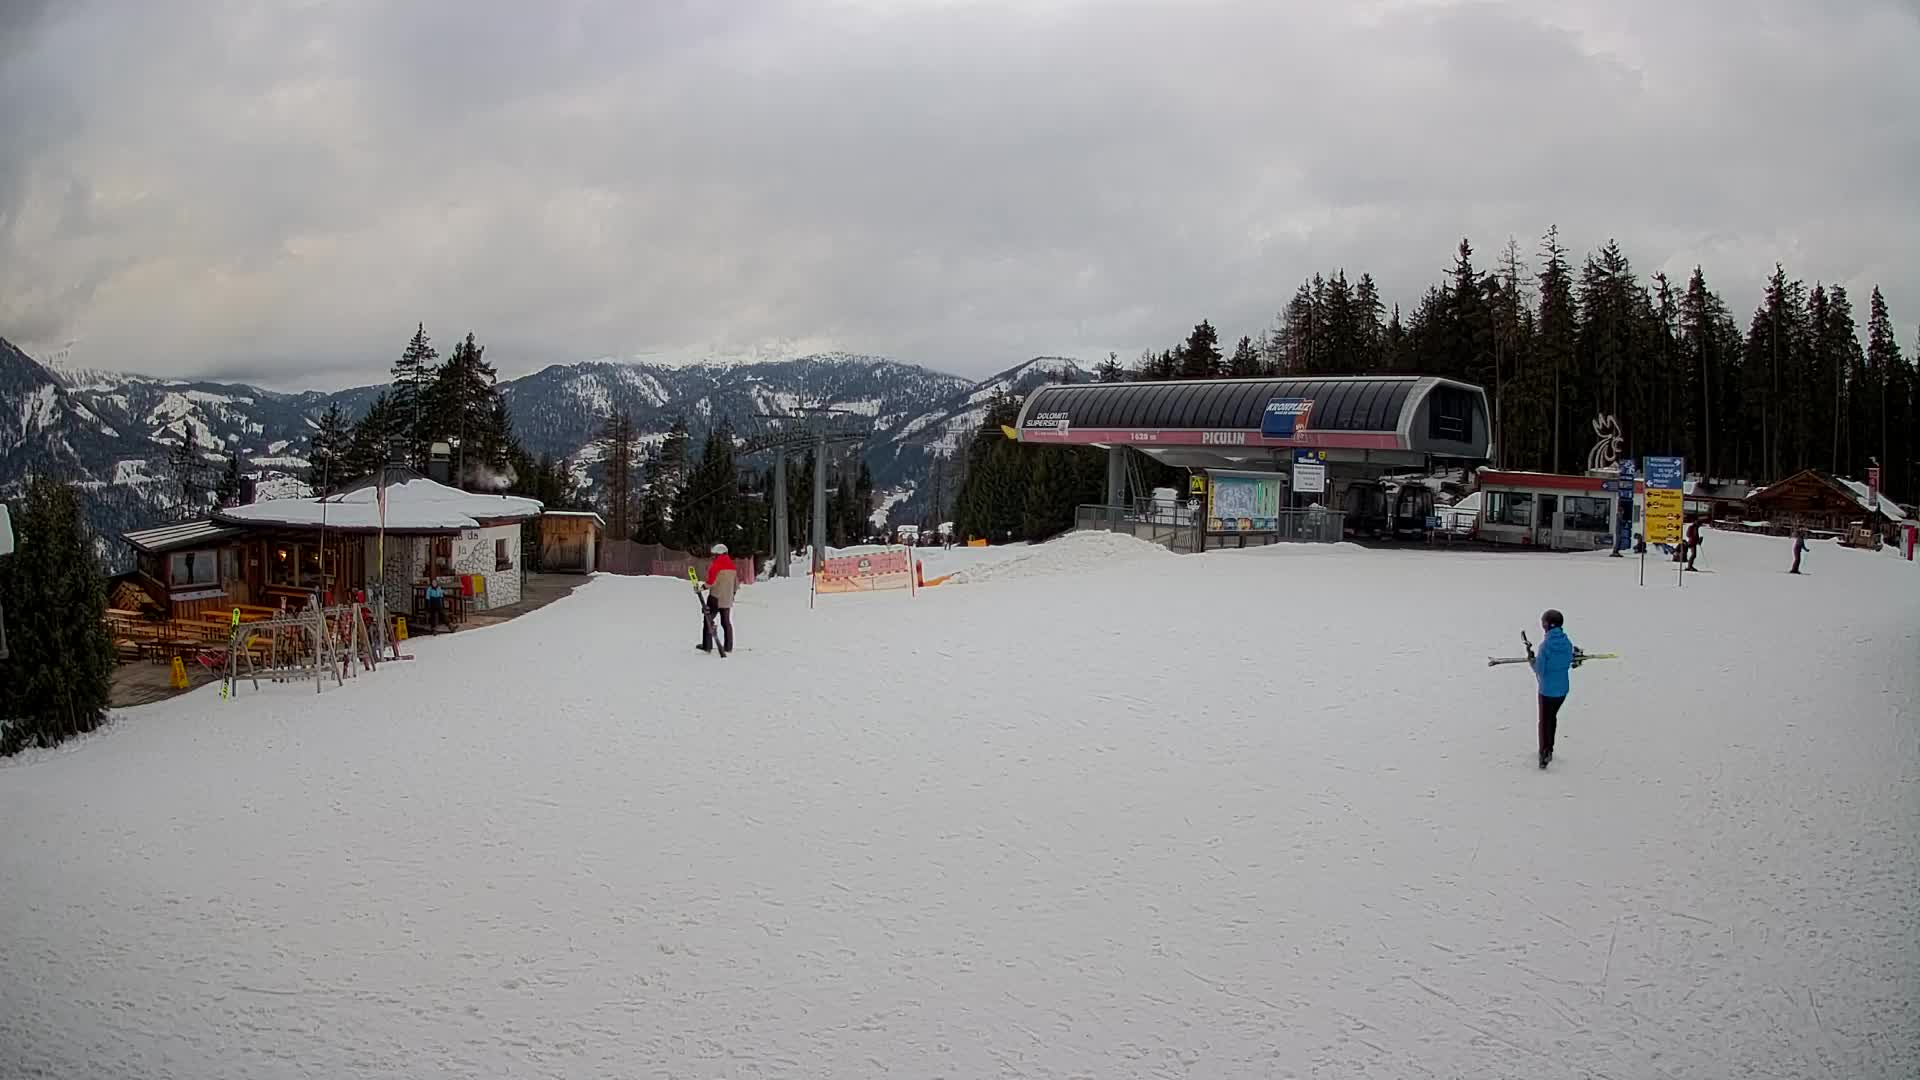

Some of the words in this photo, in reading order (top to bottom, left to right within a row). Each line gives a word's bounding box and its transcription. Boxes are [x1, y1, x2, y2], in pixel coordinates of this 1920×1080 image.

[1266, 402, 1313, 411] KRONPLATZ
[1036, 412, 1069, 420] DOLOMITI
[1202, 431, 1245, 445] PICULIN
